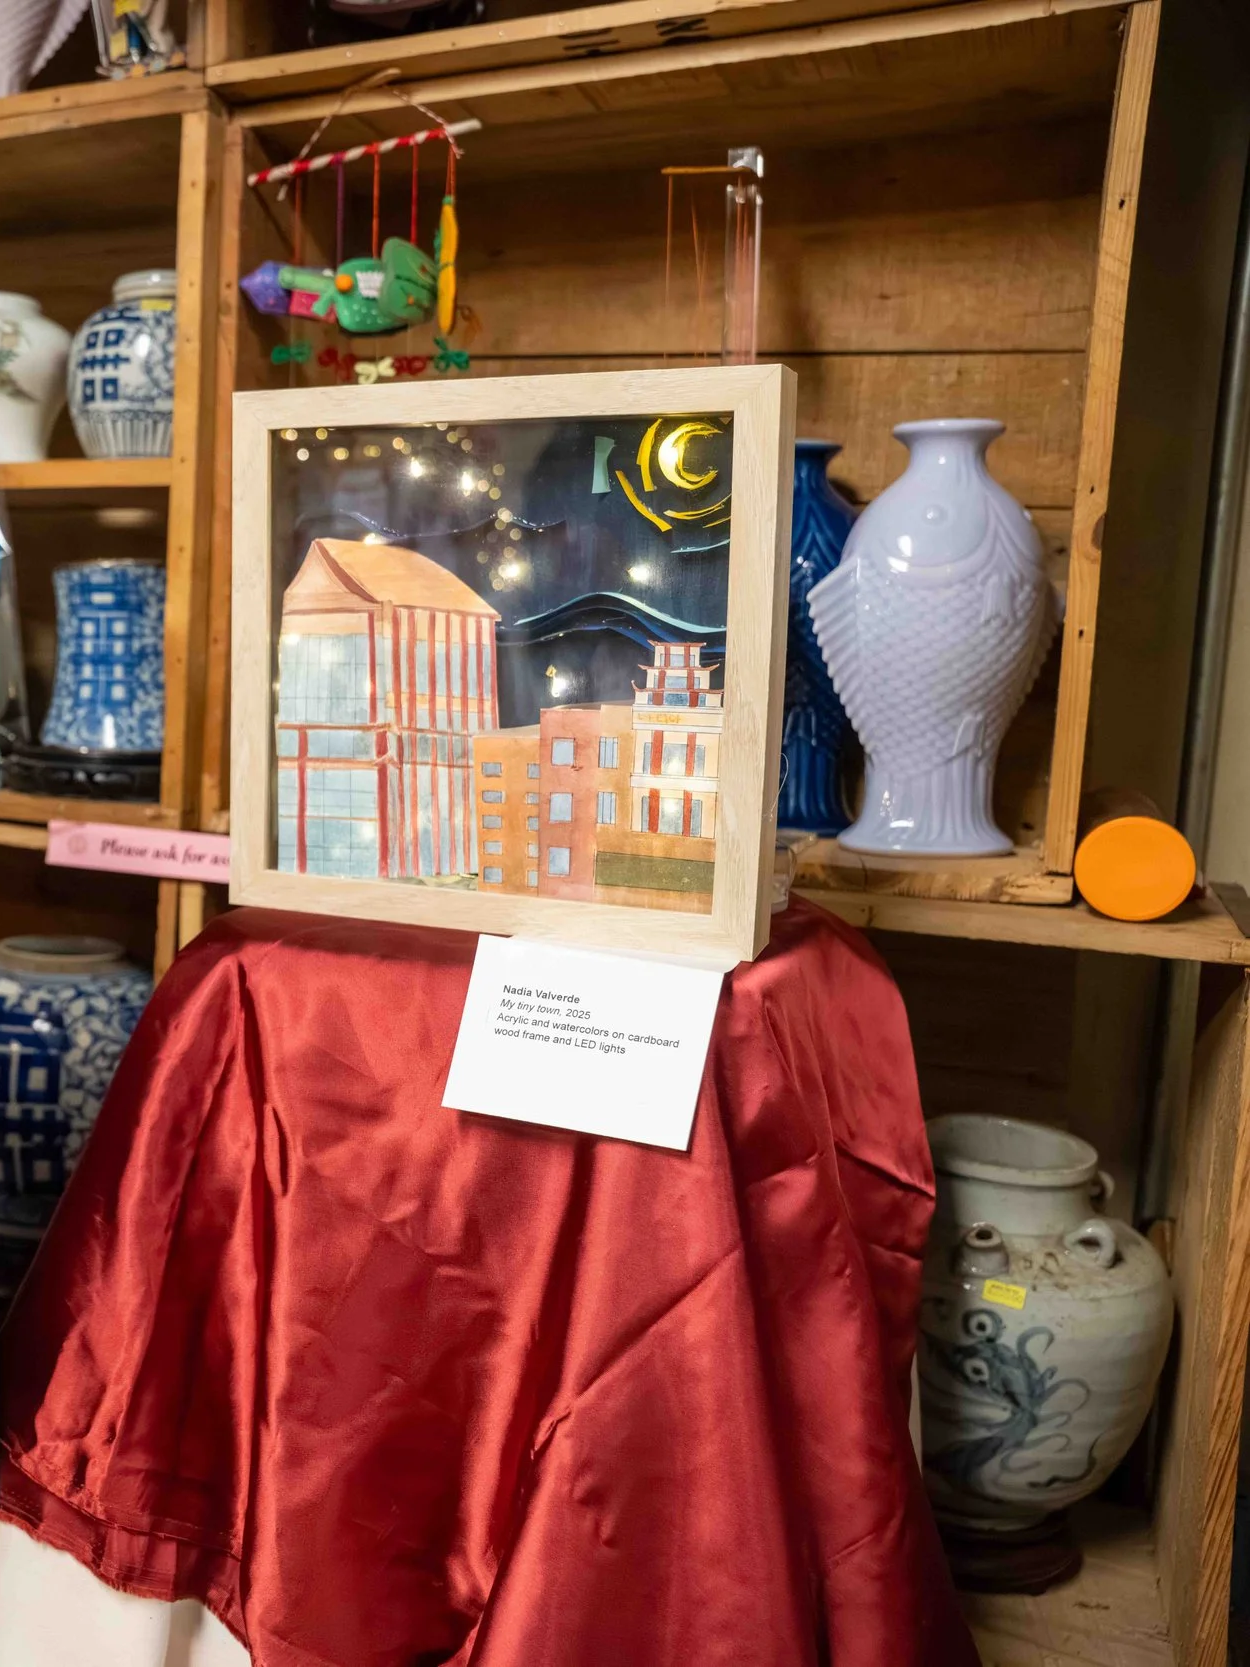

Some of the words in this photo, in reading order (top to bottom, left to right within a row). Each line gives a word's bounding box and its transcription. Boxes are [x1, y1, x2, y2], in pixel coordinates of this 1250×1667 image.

[100, 838, 149, 857] Please
[152, 843, 177, 861] ask
[182, 845, 207, 865] for
[503, 984, 533, 997] Nadia
[535, 989, 581, 1004] Valverde
[500, 998, 516, 1010] My
[517, 1001, 536, 1013] tiny
[536, 1004, 562, 1017] town,
[565, 1008, 591, 1020] 2025
[494, 1027, 520, 1038] wood
[522, 1029, 551, 1043] frame
[552, 1035, 572, 1046] and
[574, 1038, 597, 1050] LED
[598, 1041, 626, 1055] lights
[496, 1012, 529, 1025] Acrylic
[531, 1018, 550, 1028] and
[552, 1021, 610, 1037] watercolors
[612, 1031, 625, 1040] on
[627, 1033, 680, 1048] cardboard
